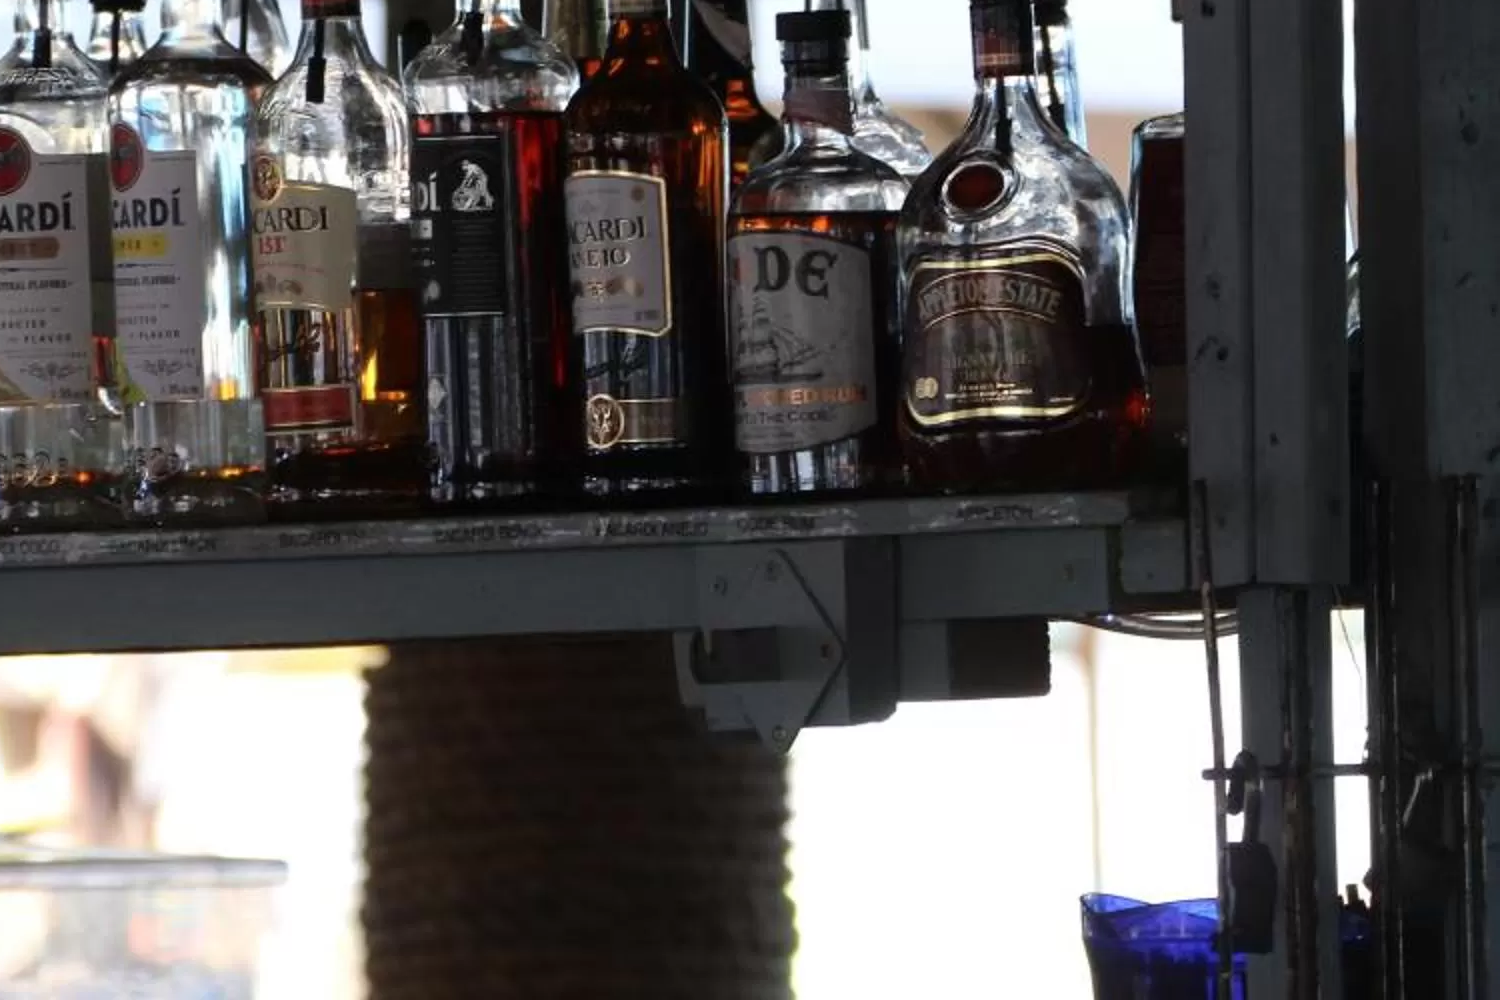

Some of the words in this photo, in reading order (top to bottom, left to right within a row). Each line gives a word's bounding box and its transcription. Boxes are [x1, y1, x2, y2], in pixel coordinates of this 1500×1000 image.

[113, 186, 181, 229] CARDÍ
[252, 204, 329, 234] CARDI
[569, 215, 646, 245] CARDI
[753, 244, 838, 299] DE
